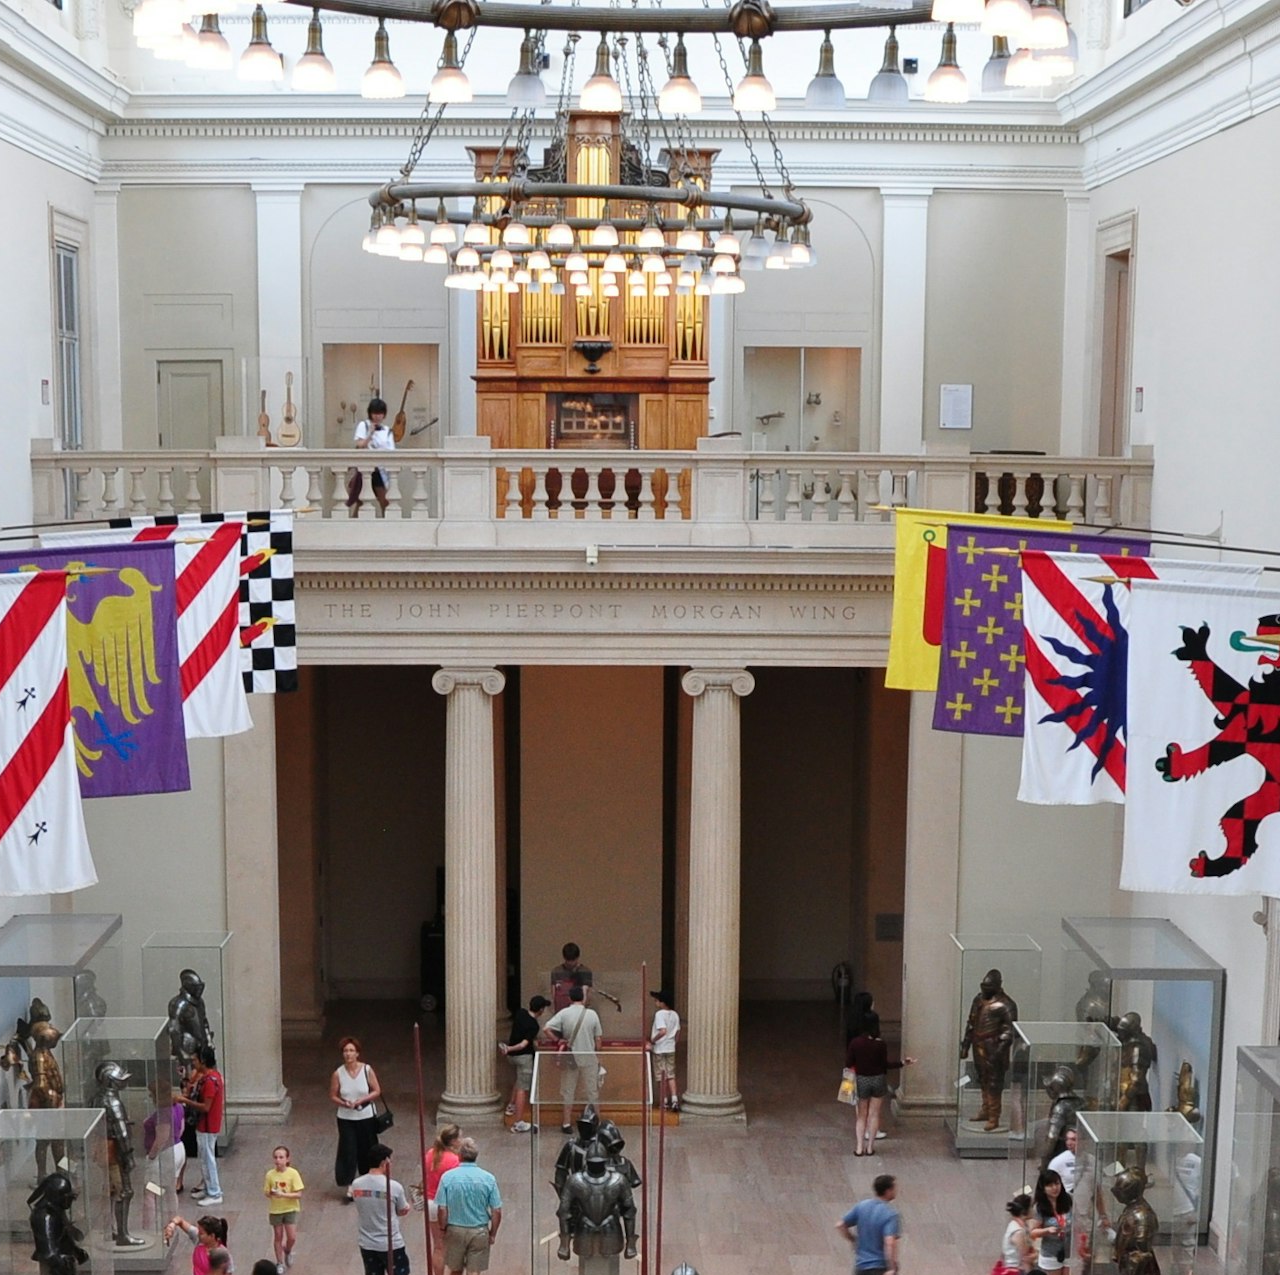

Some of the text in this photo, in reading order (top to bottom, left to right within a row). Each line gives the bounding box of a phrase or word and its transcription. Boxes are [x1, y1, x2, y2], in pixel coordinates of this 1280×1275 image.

[323, 603, 858, 620] THE JOHN PIERPONT MORGAN WING
